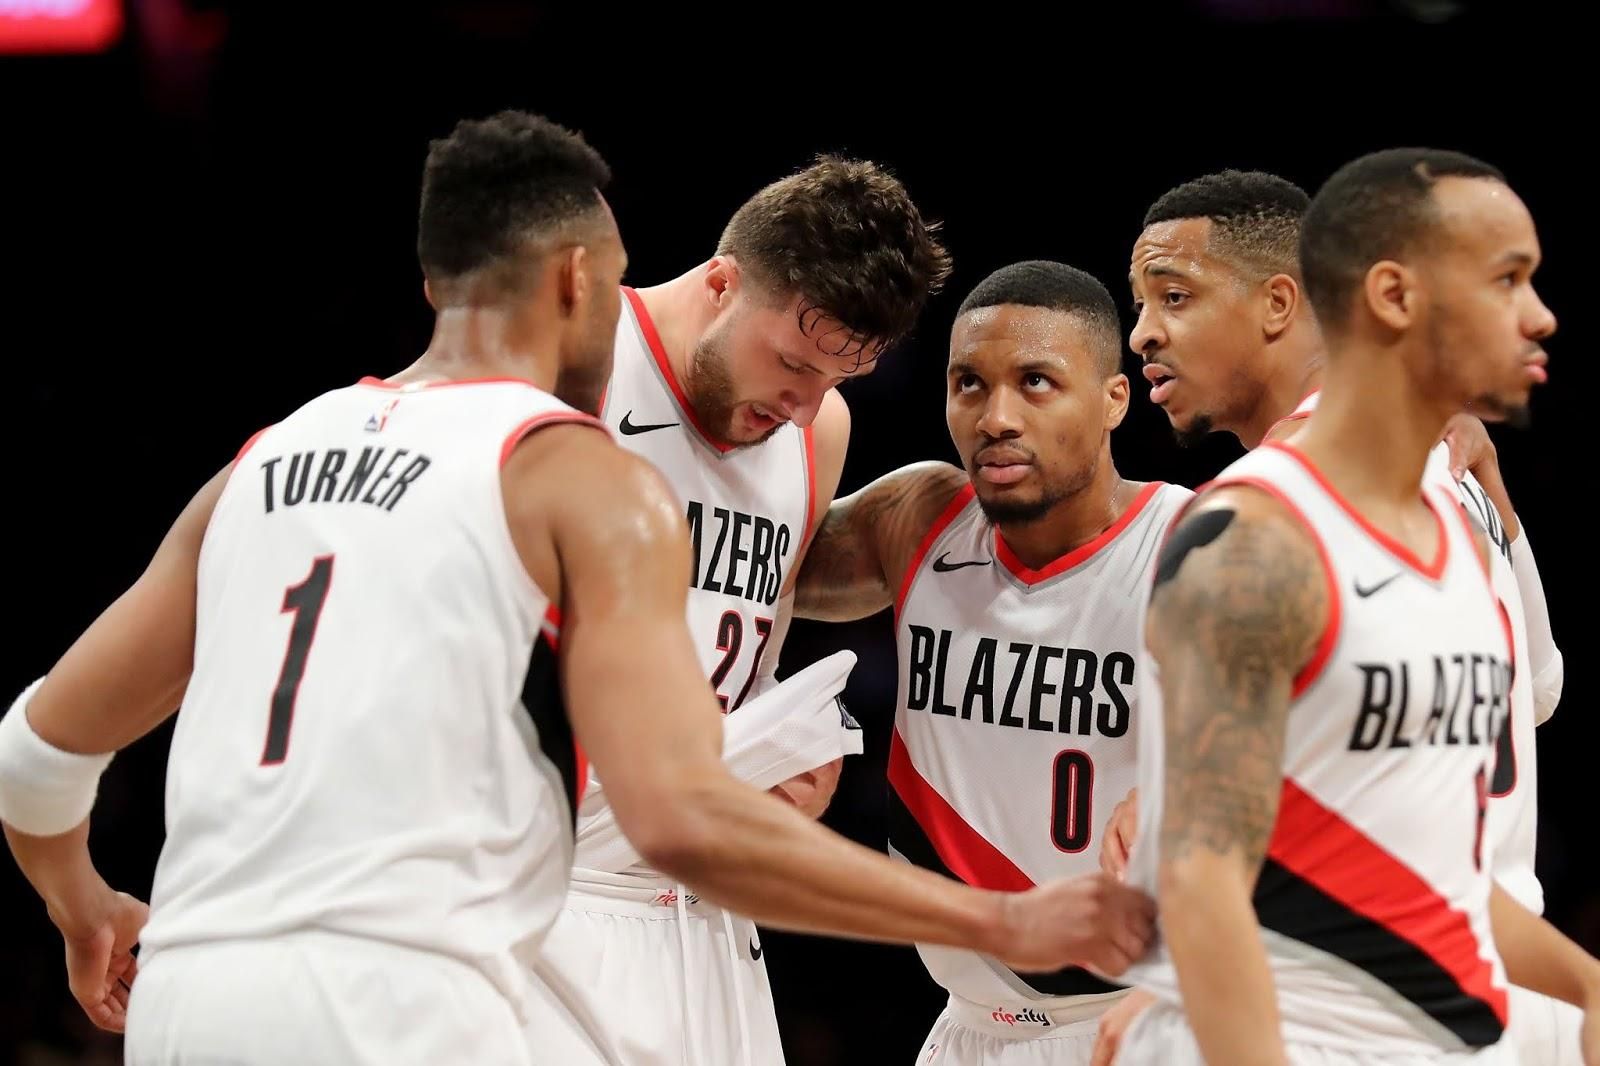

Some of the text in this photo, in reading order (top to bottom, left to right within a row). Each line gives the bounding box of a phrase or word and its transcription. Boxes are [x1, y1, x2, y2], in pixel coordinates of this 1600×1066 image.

[261, 446, 432, 514] TURNER
[683, 500, 790, 606] AZERS
[259, 552, 335, 767] 1
[711, 609, 774, 715] 27
[907, 624, 1135, 738] BLAZERS
[1050, 748, 1094, 854] 0
[992, 1006, 1051, 1027] ripcity
